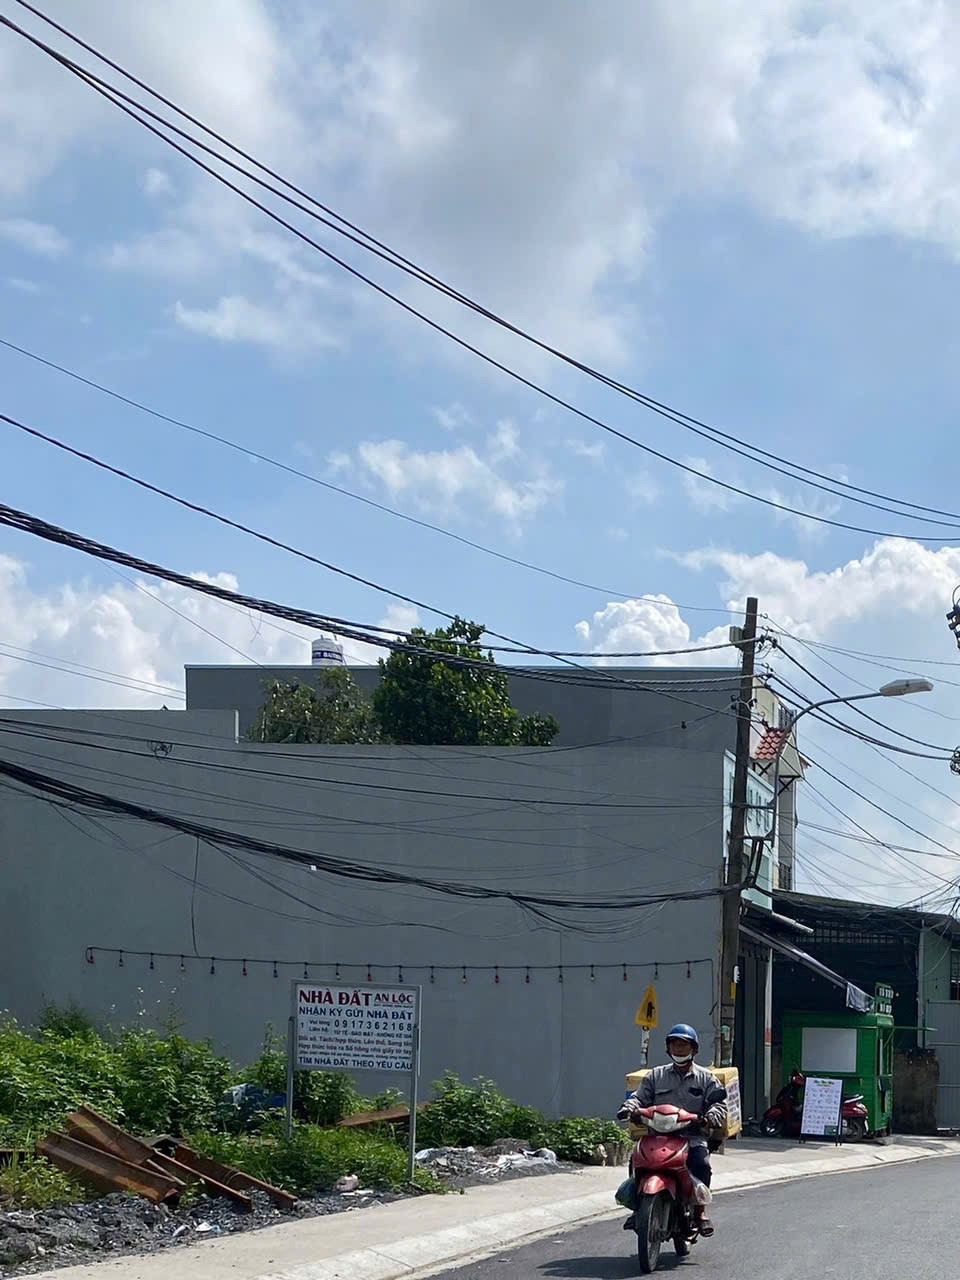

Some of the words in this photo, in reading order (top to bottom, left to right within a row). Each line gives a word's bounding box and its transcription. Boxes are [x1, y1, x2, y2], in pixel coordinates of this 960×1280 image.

[300, 988, 333, 1004] NHÀ
[338, 990, 372, 1006] ĐẤT
[374, 993, 389, 1002] AN
[300, 1006, 326, 1016] NHẬN
[346, 1008, 364, 1018] GỬI
[367, 1009, 388, 1019] NHÀ
[392, 1010, 413, 1020] ĐẤT
[298, 1056, 312, 1064] TÌM
[314, 1057, 332, 1065] NHÀ
[352, 1060, 374, 1068] THEO
